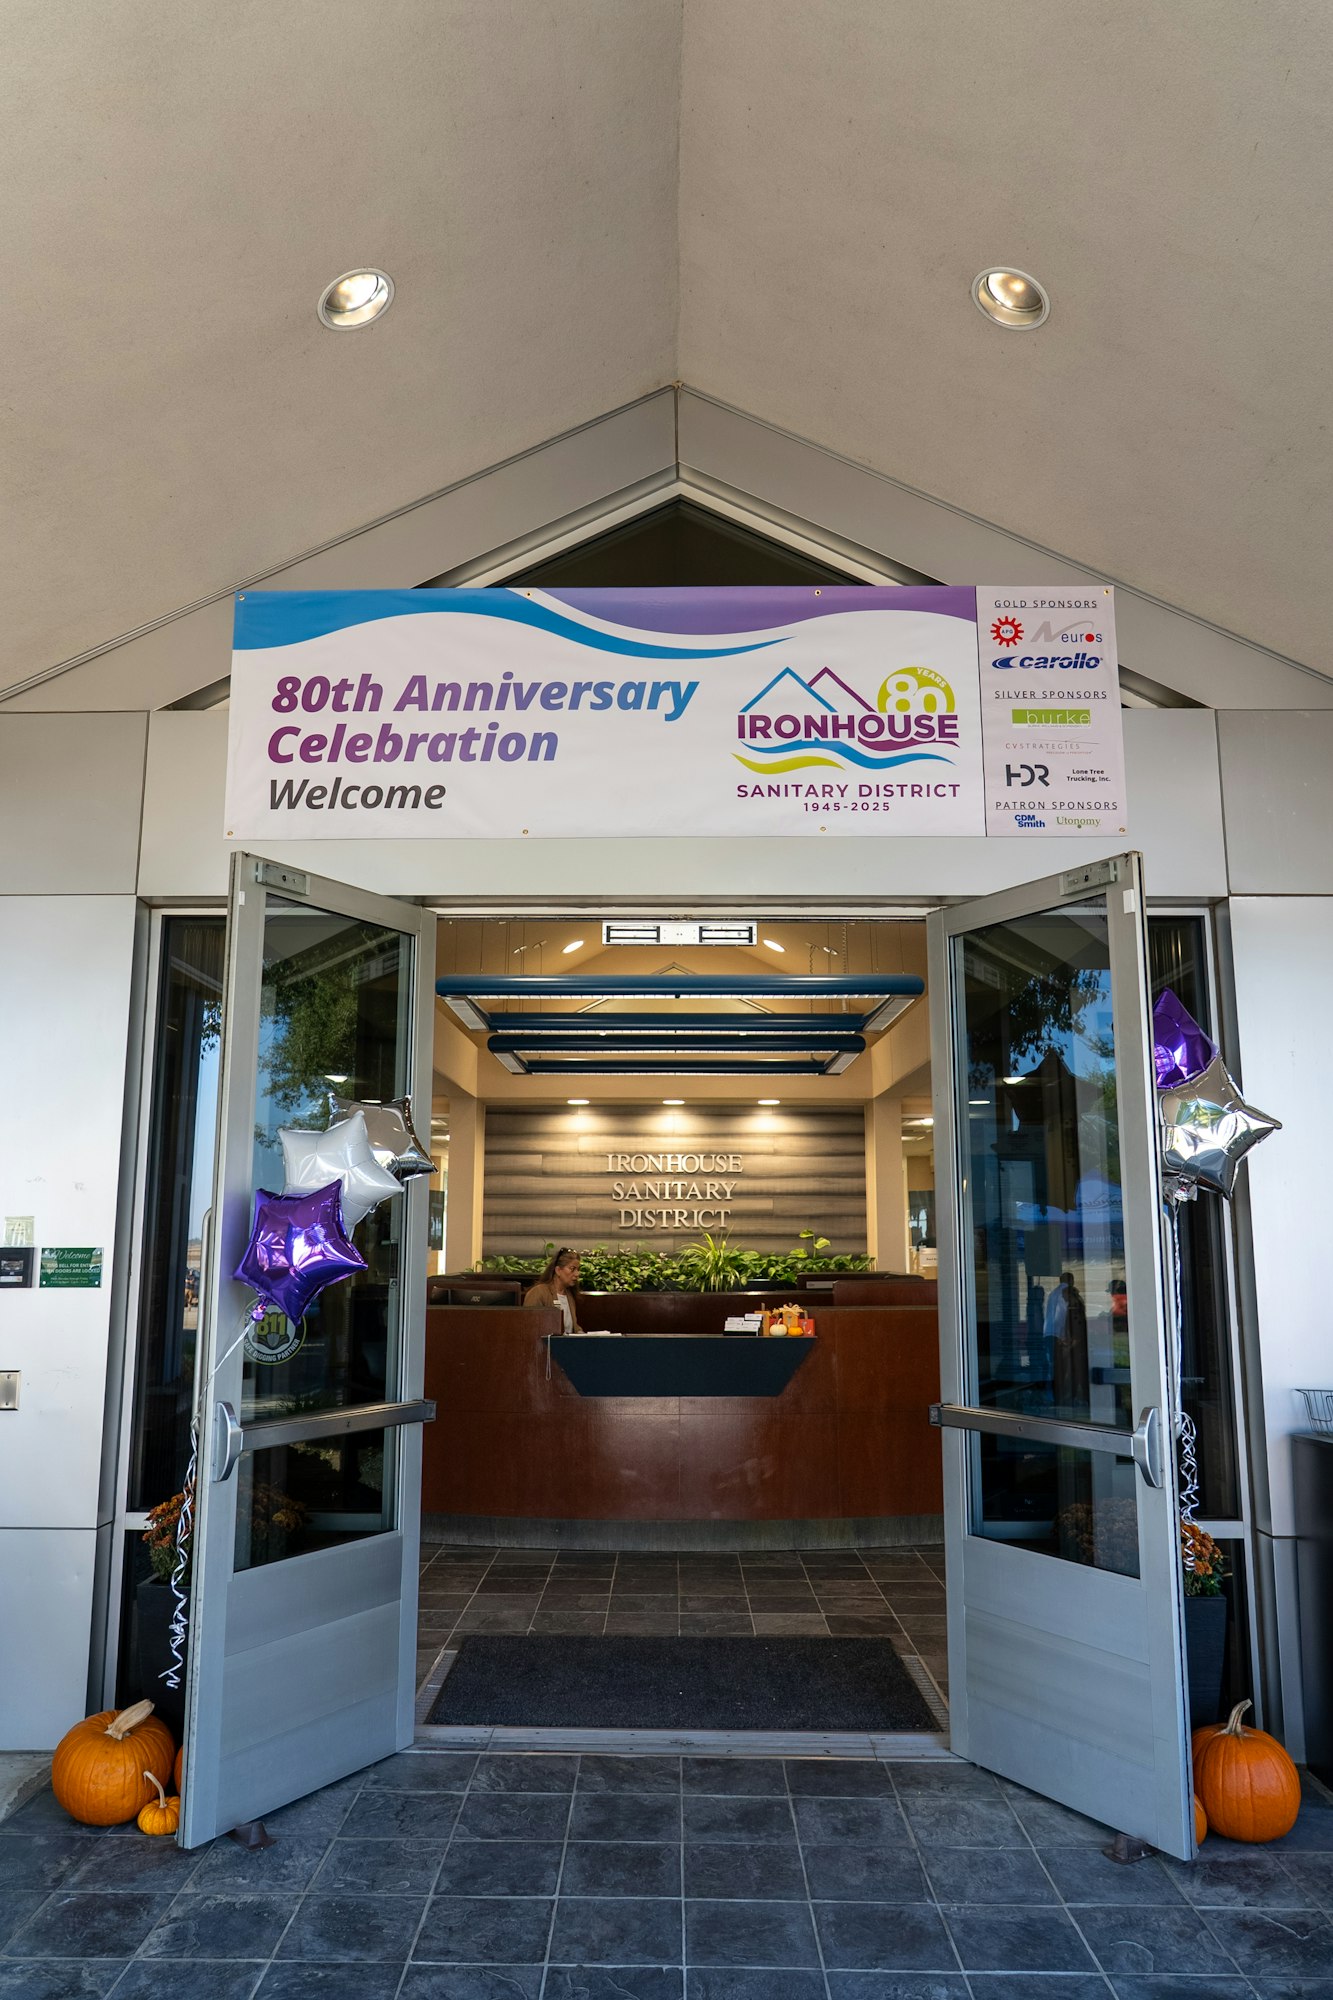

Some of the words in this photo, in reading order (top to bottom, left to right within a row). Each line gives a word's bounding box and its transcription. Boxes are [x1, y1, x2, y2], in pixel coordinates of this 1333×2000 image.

[994, 600, 1027, 608] GOLD
[1033, 600, 1097, 608] SPONSORS
[1019, 653, 1100, 669] carollo
[917, 667, 948, 689] YEARS
[271, 673, 383, 713] 80th
[394, 671, 700, 722] Anniversary
[885, 673, 948, 713] 80
[994, 691, 1036, 699] SILVER
[1042, 691, 1108, 699] SPONSORS
[1026, 710, 1091, 724] burke
[737, 714, 960, 739] IRONHOUSE
[267, 721, 558, 763] Celebration
[1005, 764, 1050, 787] HDR
[269, 777, 447, 810] Welcome
[737, 784, 849, 798] SANITARY
[858, 784, 961, 798] DISTRICT
[803, 802, 890, 812] 1945-2025
[995, 802, 1046, 810] PATRON
[1052, 802, 1118, 810] SPONSORS
[1014, 814, 1036, 822] CDM
[1017, 820, 1046, 828] Smith
[1056, 816, 1101, 827] Utonomy
[606, 1154, 744, 1174] IRONHOUSE
[612, 1181, 737, 1201] SANITARY
[618, 1208, 731, 1229] DISTRICT
[52, 1250, 90, 1259] Welcome
[244, 1338, 253, 1353] SAFE
[252, 1352, 277, 1362] DIGGING
[277, 1338, 300, 1360] PARTNER
